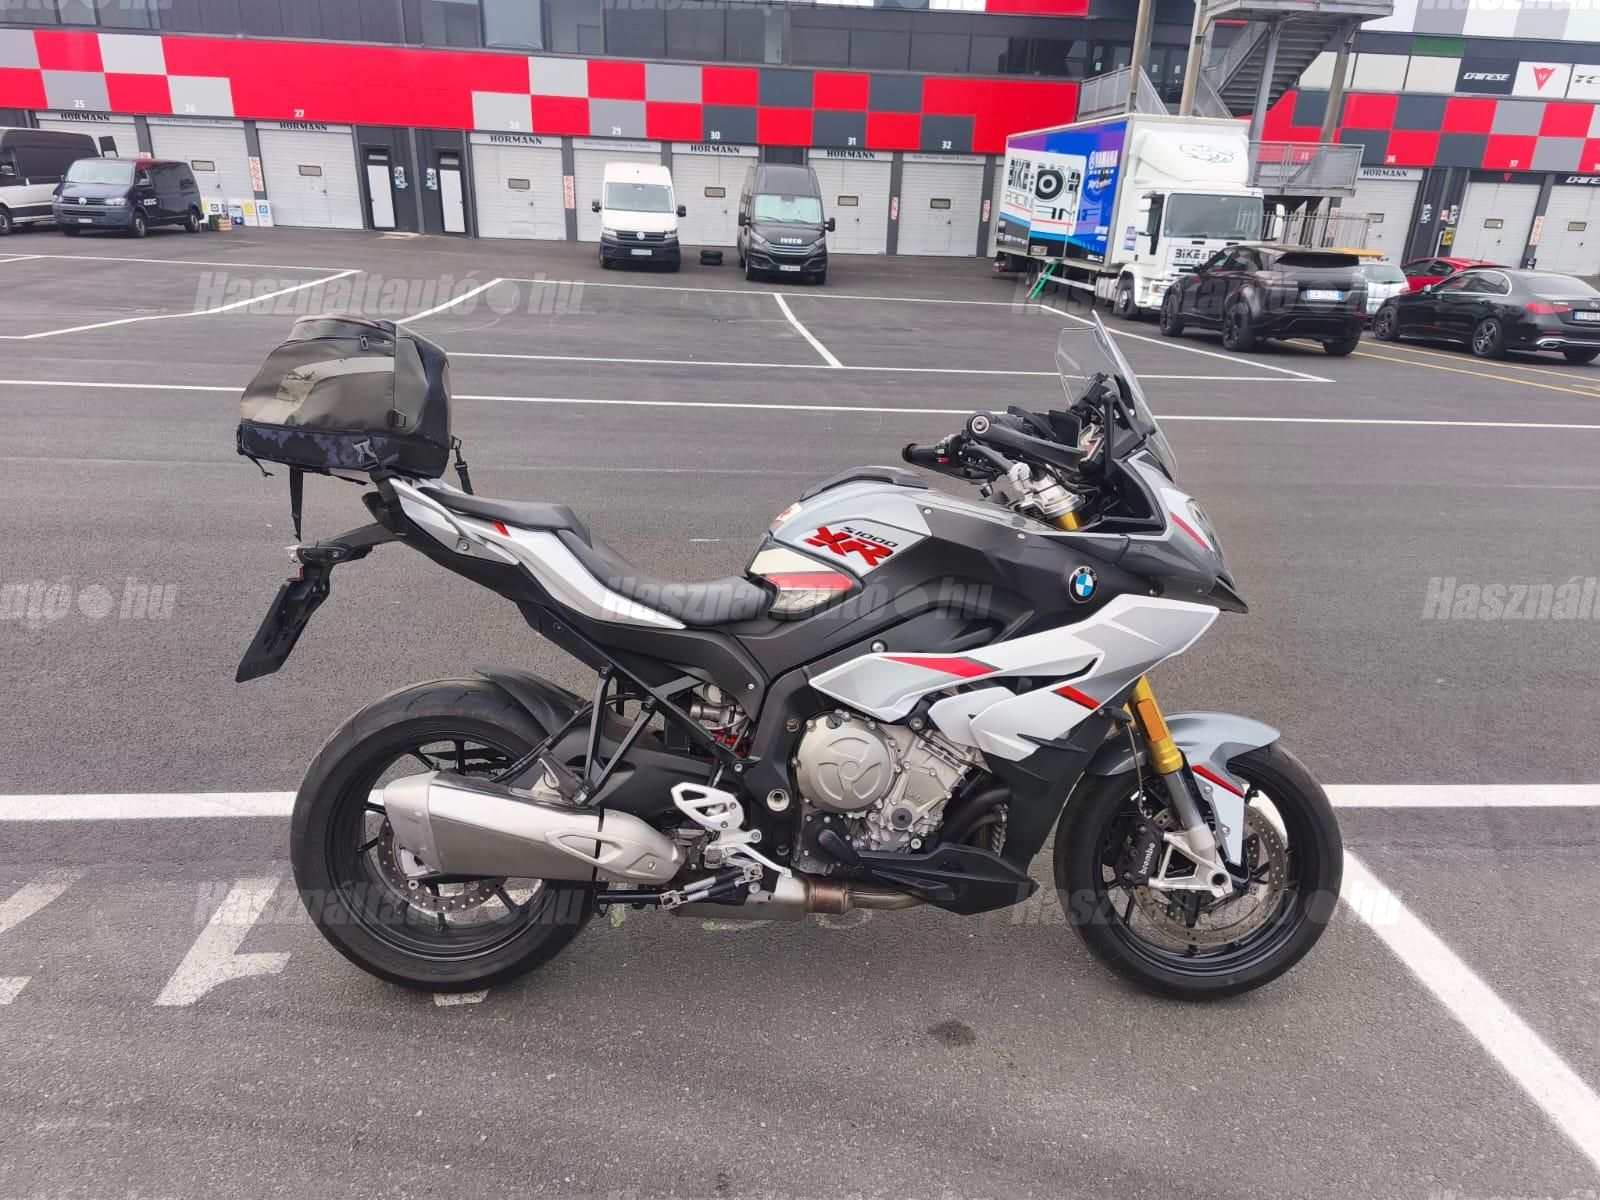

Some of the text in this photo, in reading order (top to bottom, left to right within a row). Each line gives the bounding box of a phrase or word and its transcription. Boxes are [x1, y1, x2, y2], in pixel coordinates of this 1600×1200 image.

[1463, 72, 1511, 81] DAINESE
[73, 99, 85, 108] 25
[294, 109, 305, 118] 27
[710, 130, 721, 140] 30
[847, 136, 857, 146] 31
[942, 140, 952, 149] 32
[803, 526, 894, 567] XR
[1138, 842, 1156, 875] brembo
